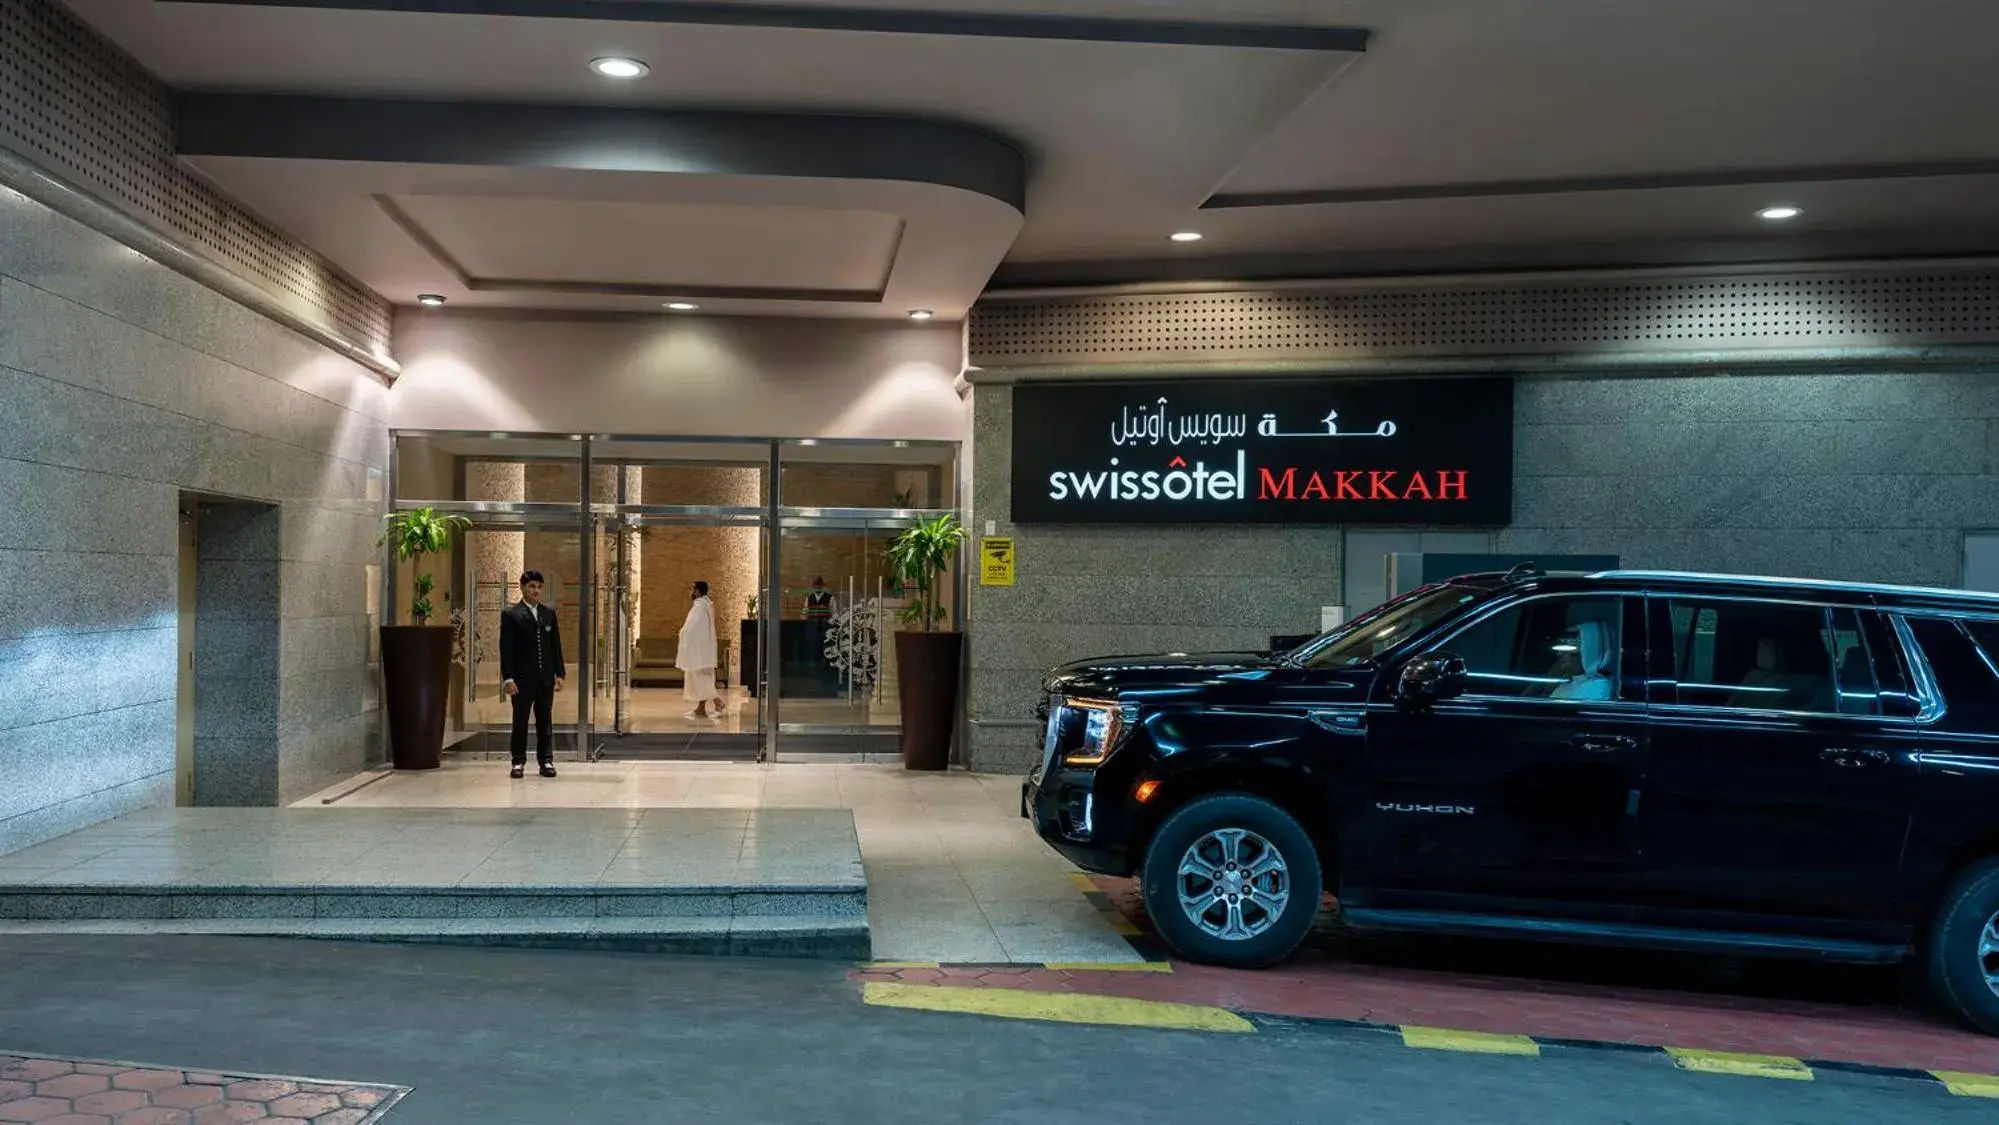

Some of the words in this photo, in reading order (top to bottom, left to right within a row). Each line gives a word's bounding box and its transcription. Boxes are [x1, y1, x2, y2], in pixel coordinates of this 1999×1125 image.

[1257, 408, 1397, 437] مكة
[1048, 449, 1246, 501] swissôtel
[1257, 467, 1469, 500] MAKKAH
[1376, 802, 1475, 814] YUKON
